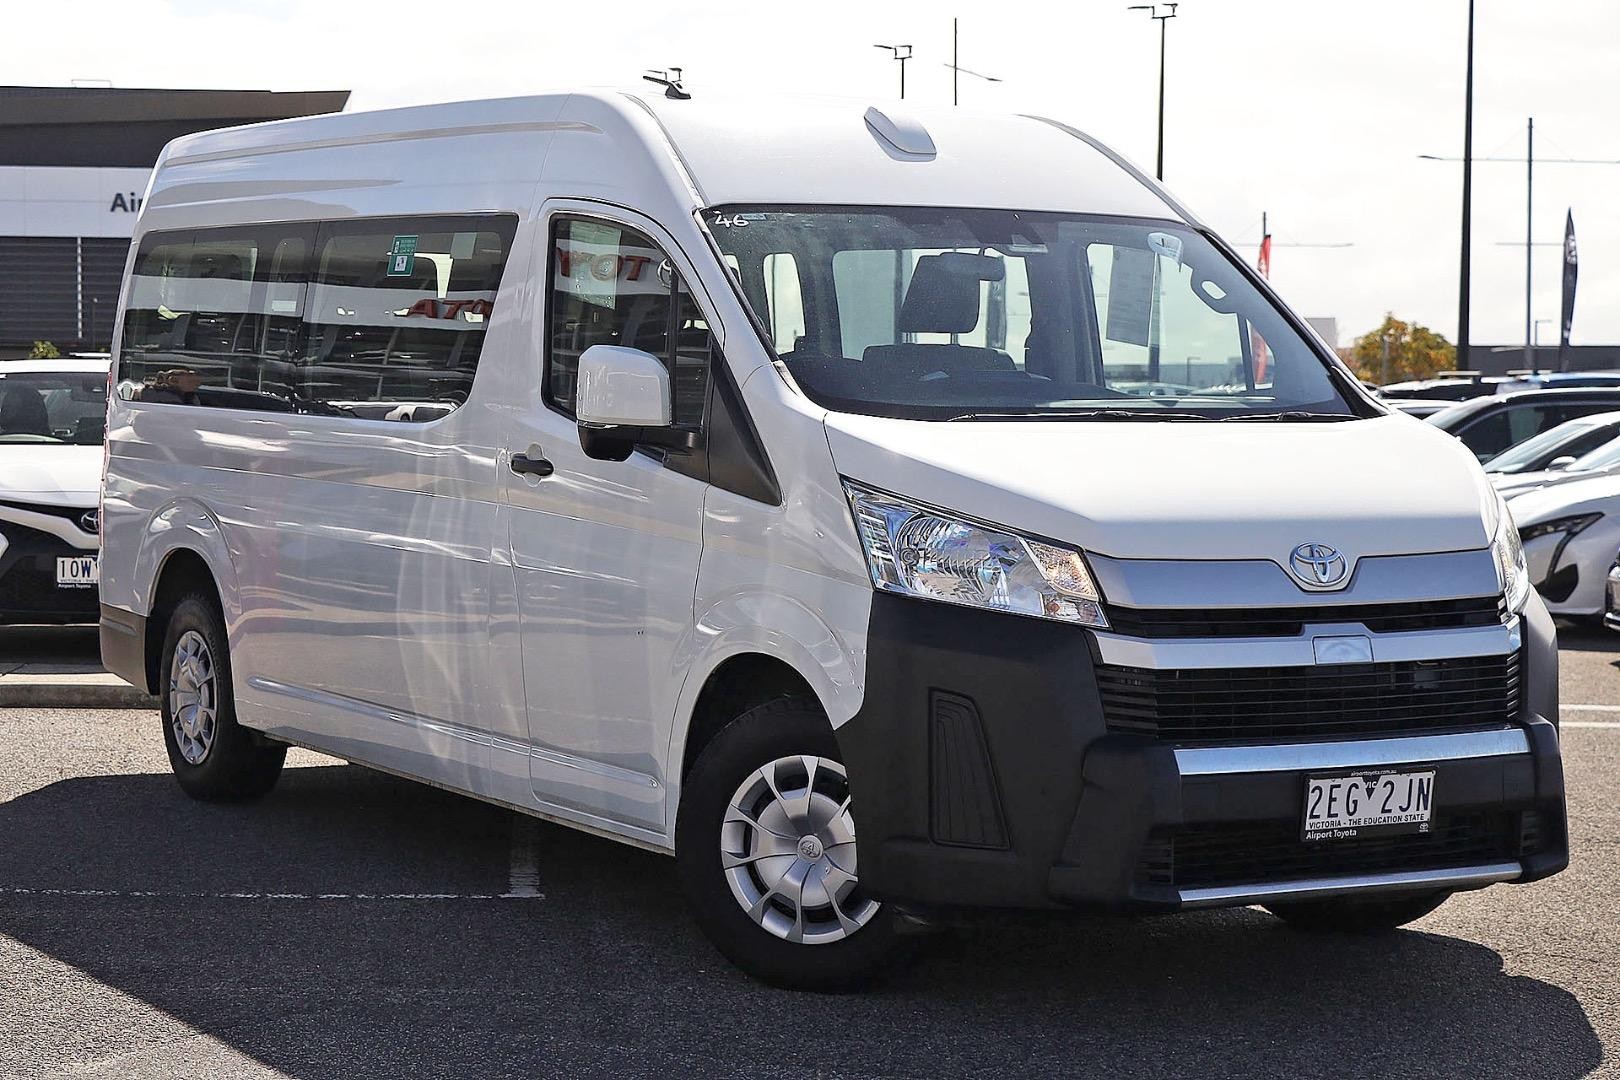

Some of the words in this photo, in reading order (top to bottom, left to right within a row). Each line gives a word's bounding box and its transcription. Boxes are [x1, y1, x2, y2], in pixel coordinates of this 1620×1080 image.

[713, 211, 749, 228] 46
[1308, 782, 1360, 819] 2EG
[1380, 777, 1431, 814] 2JN
[1308, 819, 1342, 829] VICTORIA
[1348, 818, 1361, 826] THE
[1363, 815, 1402, 825] EDUCATION
[1404, 813, 1425, 822] STATE
[1306, 829, 1333, 840] Airport
[1333, 828, 1357, 839] Toyota
